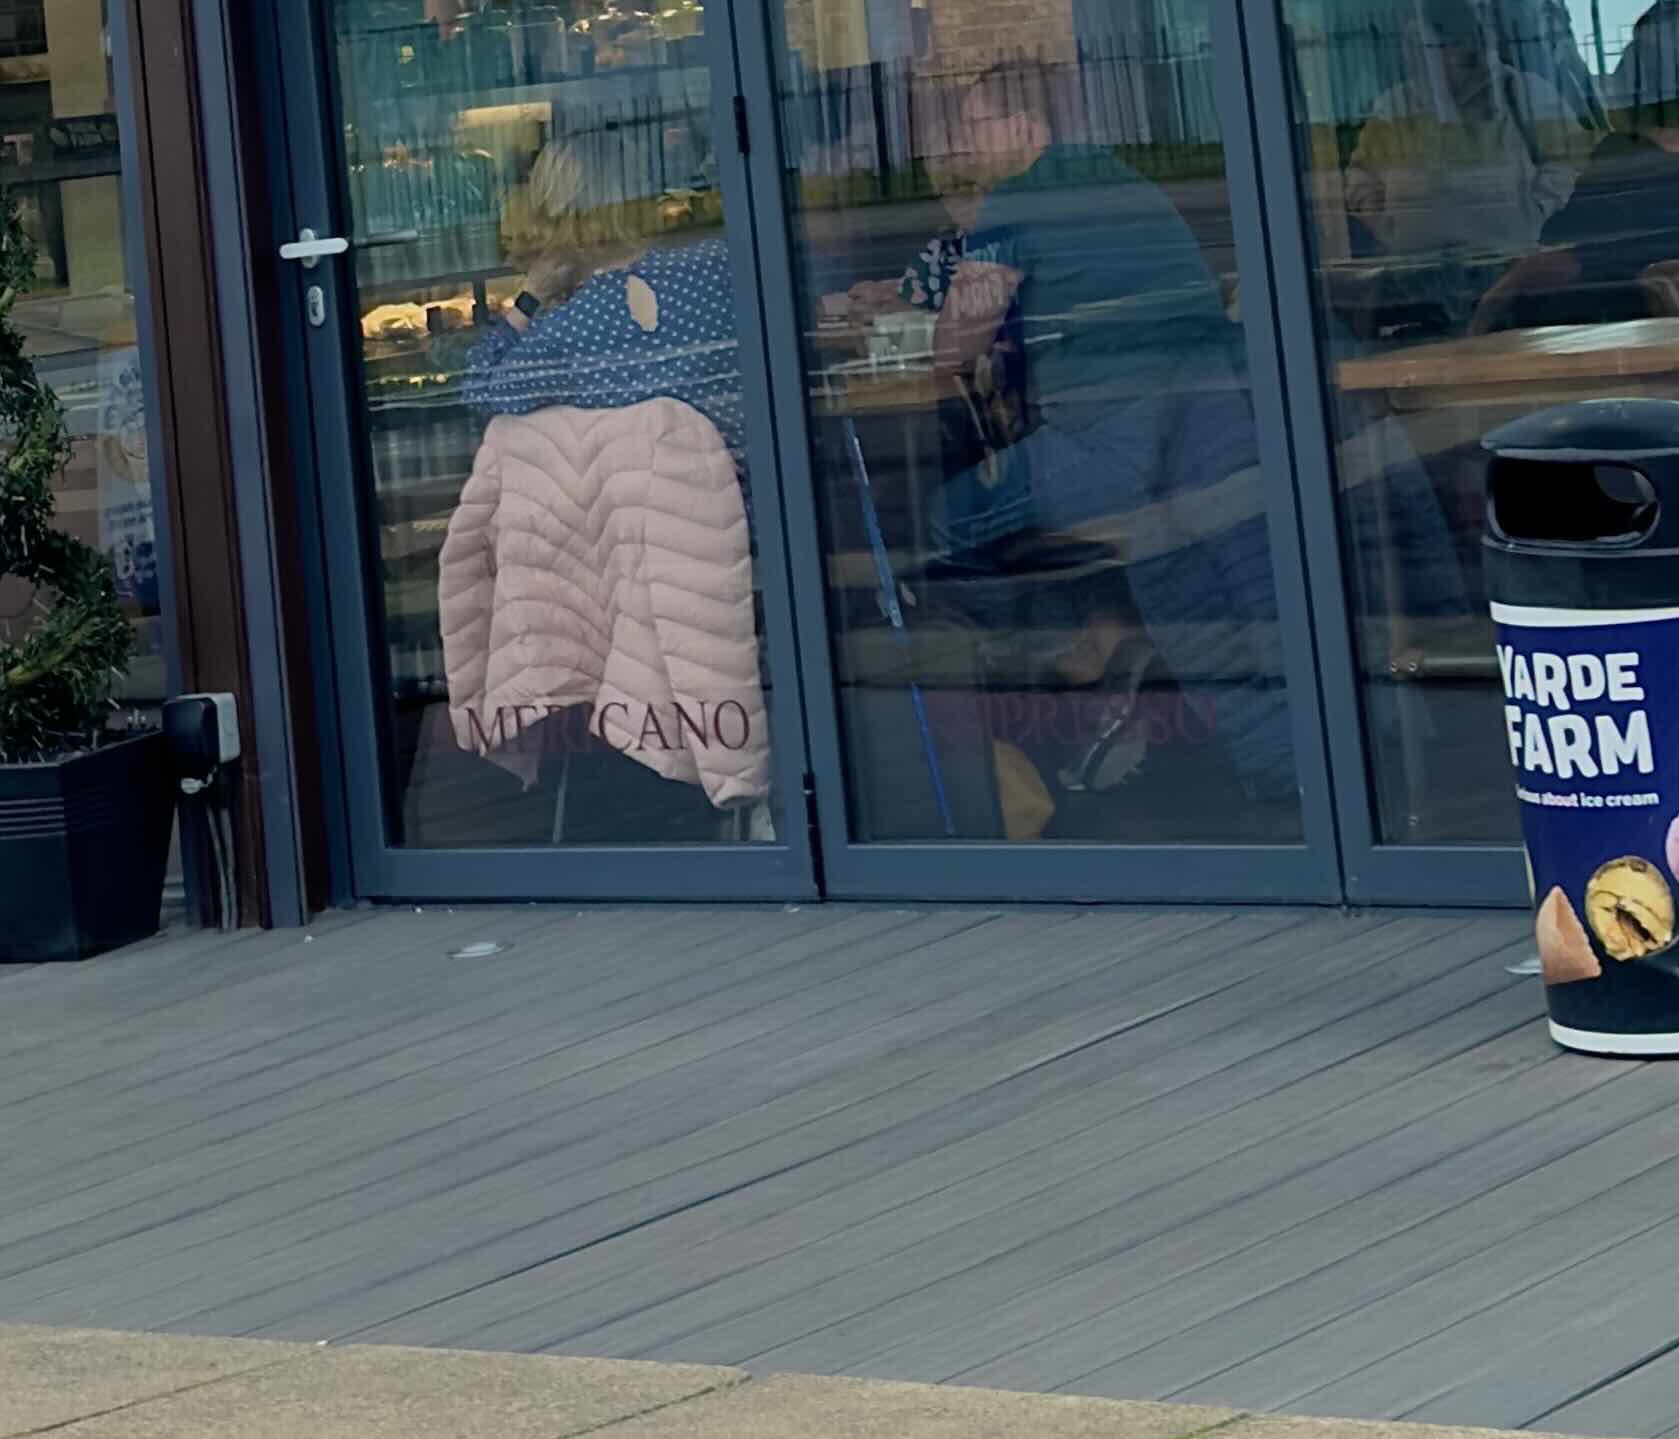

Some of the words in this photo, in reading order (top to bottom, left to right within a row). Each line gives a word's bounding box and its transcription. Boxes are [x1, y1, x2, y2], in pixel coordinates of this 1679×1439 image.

[1496, 644, 1645, 711] YARDE
[1504, 705, 1654, 780] FARM
[1580, 791, 1604, 808] ice
[1605, 792, 1660, 807] cream
